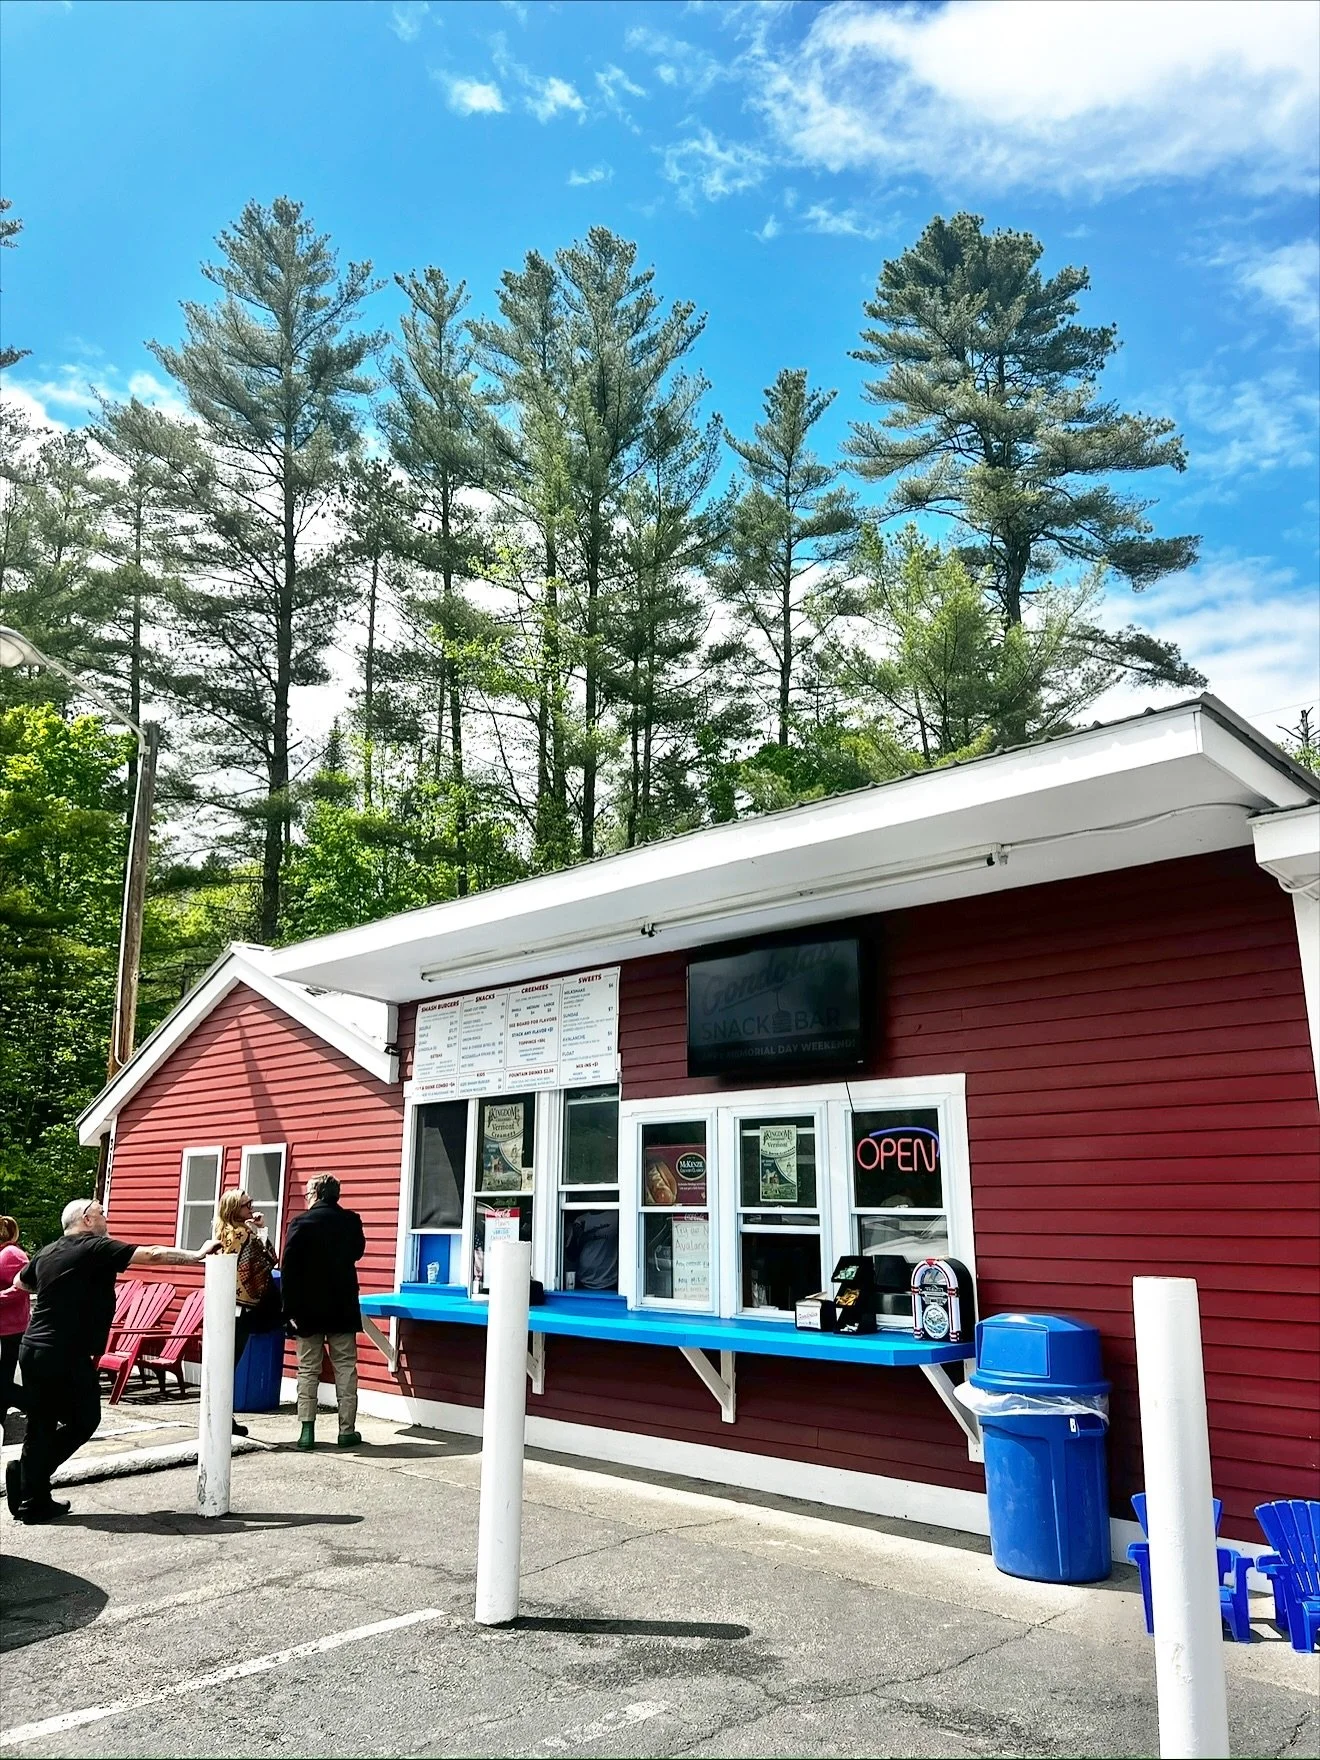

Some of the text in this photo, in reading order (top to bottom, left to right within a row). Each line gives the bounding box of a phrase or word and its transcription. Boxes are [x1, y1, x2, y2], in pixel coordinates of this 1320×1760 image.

[578, 974, 602, 984] SWEETS
[521, 984, 549, 994] CREEMEES
[475, 993, 496, 1003] SNACKS
[421, 1000, 460, 1013] SMASH BURGERS
[702, 1008, 841, 1041] SNACK BAR
[728, 1047, 776, 1060] MEMORIAL
[777, 1044, 798, 1054] DAY
[801, 1038, 856, 1051] WEEKEND!
[488, 1106, 517, 1121] KINGDOM
[492, 1122, 515, 1131] Vermont
[764, 1129, 790, 1141] KINGDOM
[857, 1137, 936, 1172] OPEN
[675, 1224, 688, 1239] Try
